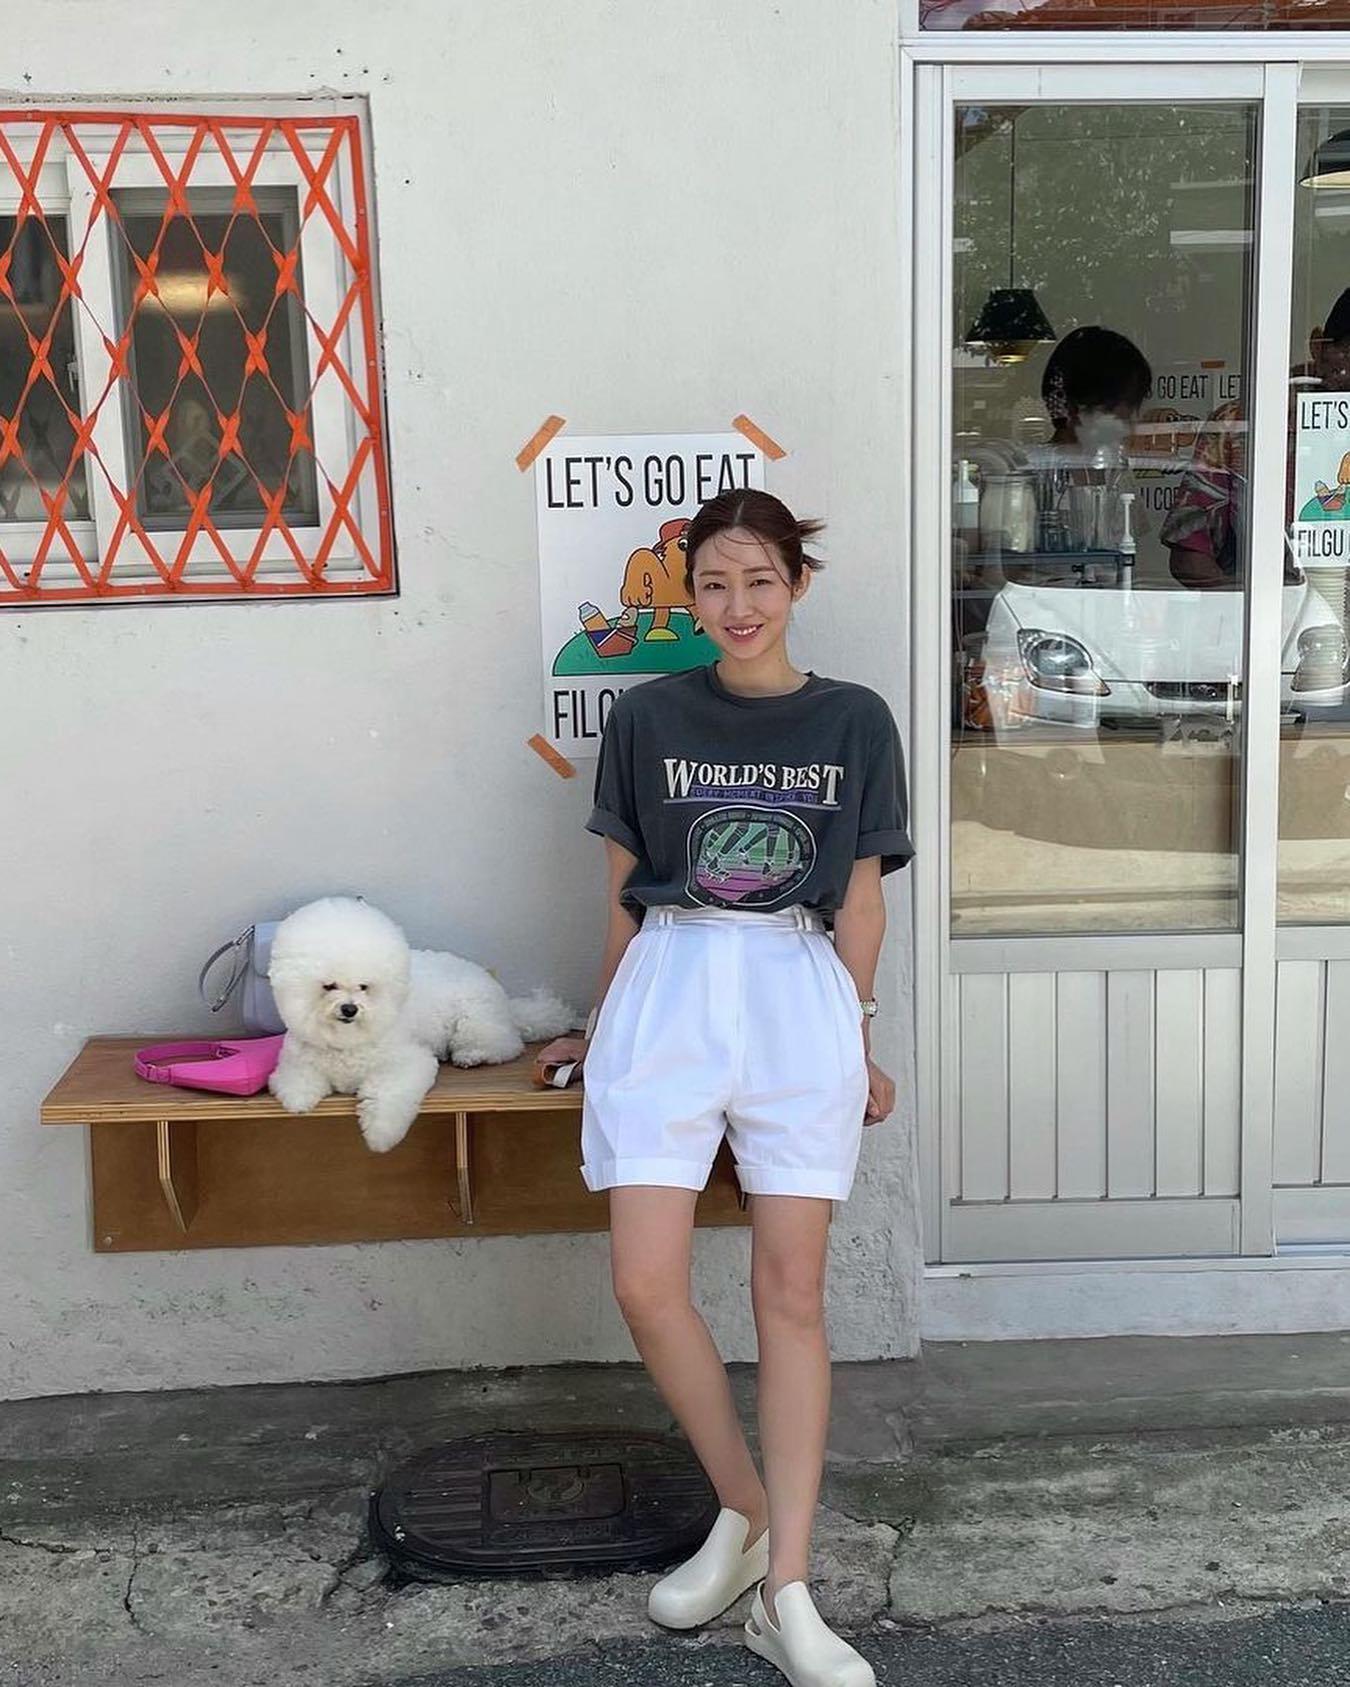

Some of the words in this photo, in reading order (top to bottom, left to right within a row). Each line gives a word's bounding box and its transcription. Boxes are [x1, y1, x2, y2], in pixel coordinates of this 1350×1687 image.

[1157, 375, 1176, 399] GO
[1180, 375, 1208, 399] EAT
[1219, 374, 1241, 399] LE
[1301, 400, 1349, 430] LET'S
[546, 455, 634, 508] LET'S
[644, 454, 685, 507] GO
[696, 453, 756, 504] EAT
[1298, 529, 1344, 558] FILGU
[553, 688, 624, 739] FIL
[663, 758, 776, 799] WORLD'S
[781, 764, 844, 805] BEST
